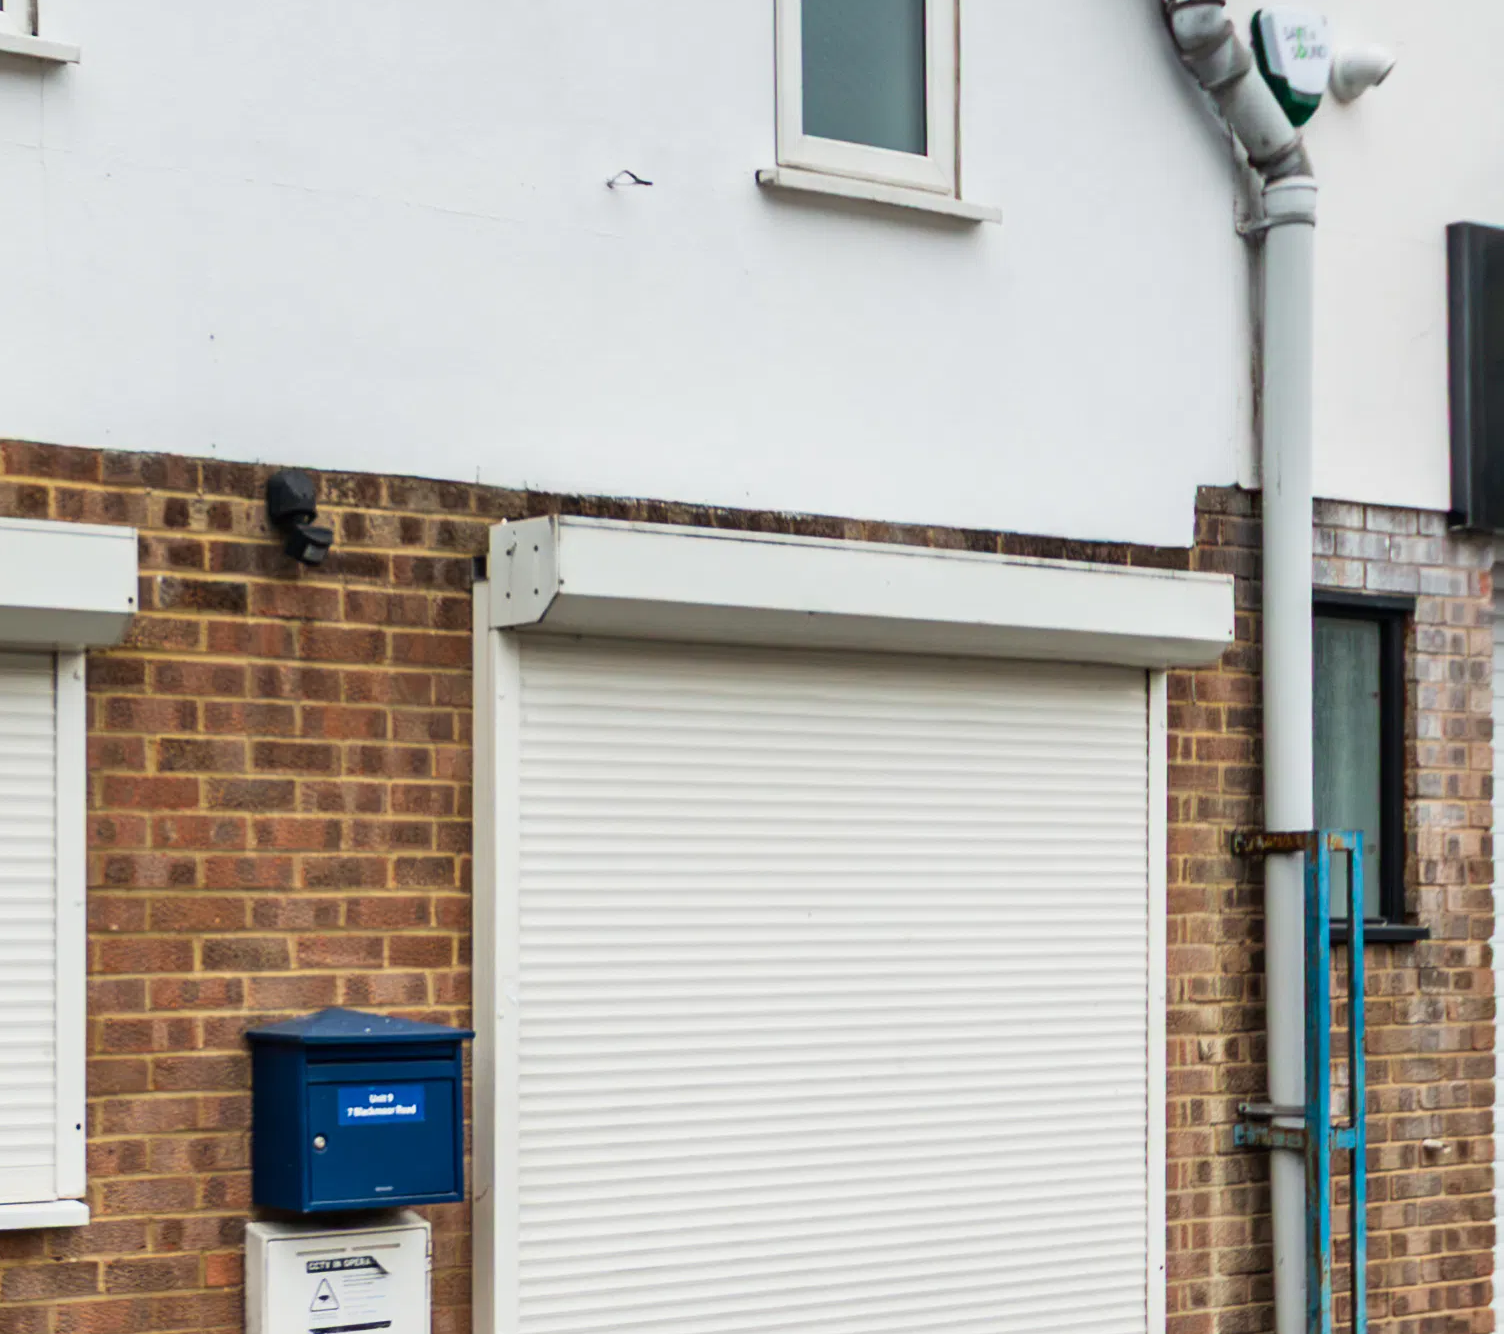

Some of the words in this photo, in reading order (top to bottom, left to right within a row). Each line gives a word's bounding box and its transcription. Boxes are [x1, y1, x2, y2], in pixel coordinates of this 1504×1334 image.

[369, 1093, 387, 1104] Unit
[308, 1261, 331, 1272] CCTV
[343, 1257, 372, 1268] OPERA
